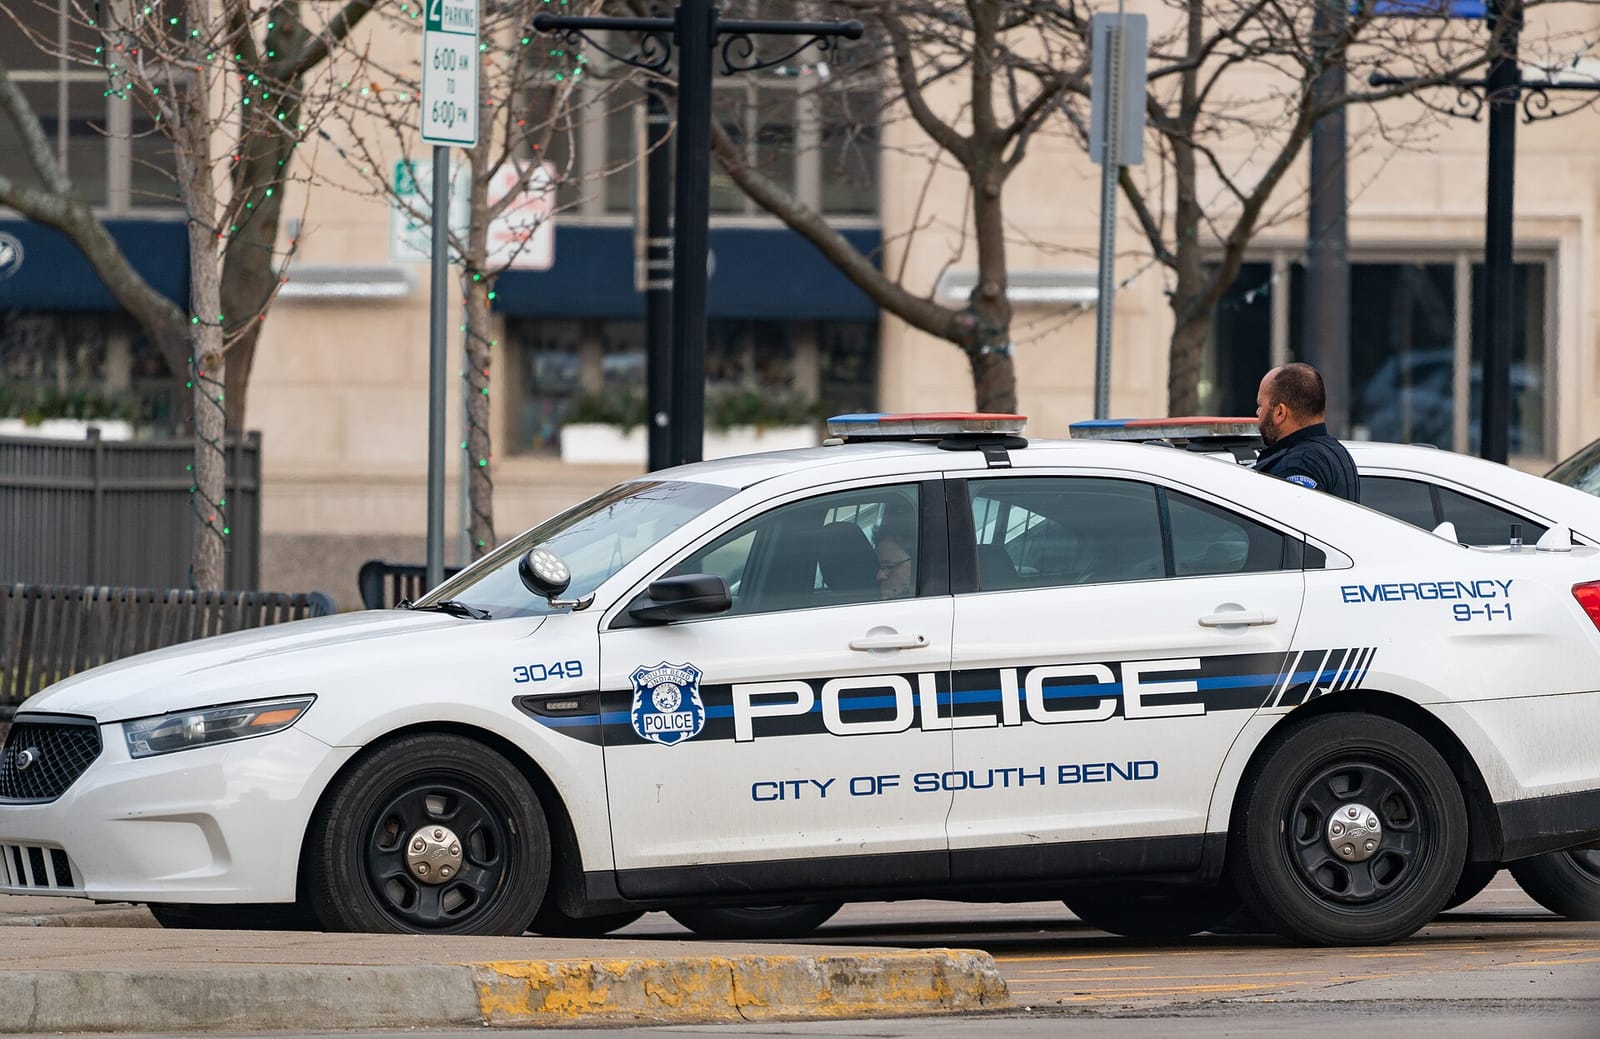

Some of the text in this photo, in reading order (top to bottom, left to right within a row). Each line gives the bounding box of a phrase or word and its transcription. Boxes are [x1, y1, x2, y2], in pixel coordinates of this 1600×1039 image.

[445, 5, 474, 28] PARKING
[433, 48, 469, 71] 6:00 AM
[447, 78, 456, 94] TO
[431, 100, 468, 123] 6:00 PM
[1340, 580, 1514, 603] EMERGENCY
[1452, 603, 1512, 621] 9-1-1
[513, 660, 583, 683] 3049
[642, 668, 691, 682] SOUTH BEND
[650, 676, 683, 686] INDIANA
[731, 657, 1206, 743] POLICE
[645, 713, 692, 731] POLICE
[751, 760, 1159, 801] CITY OF SOUTH BEND
